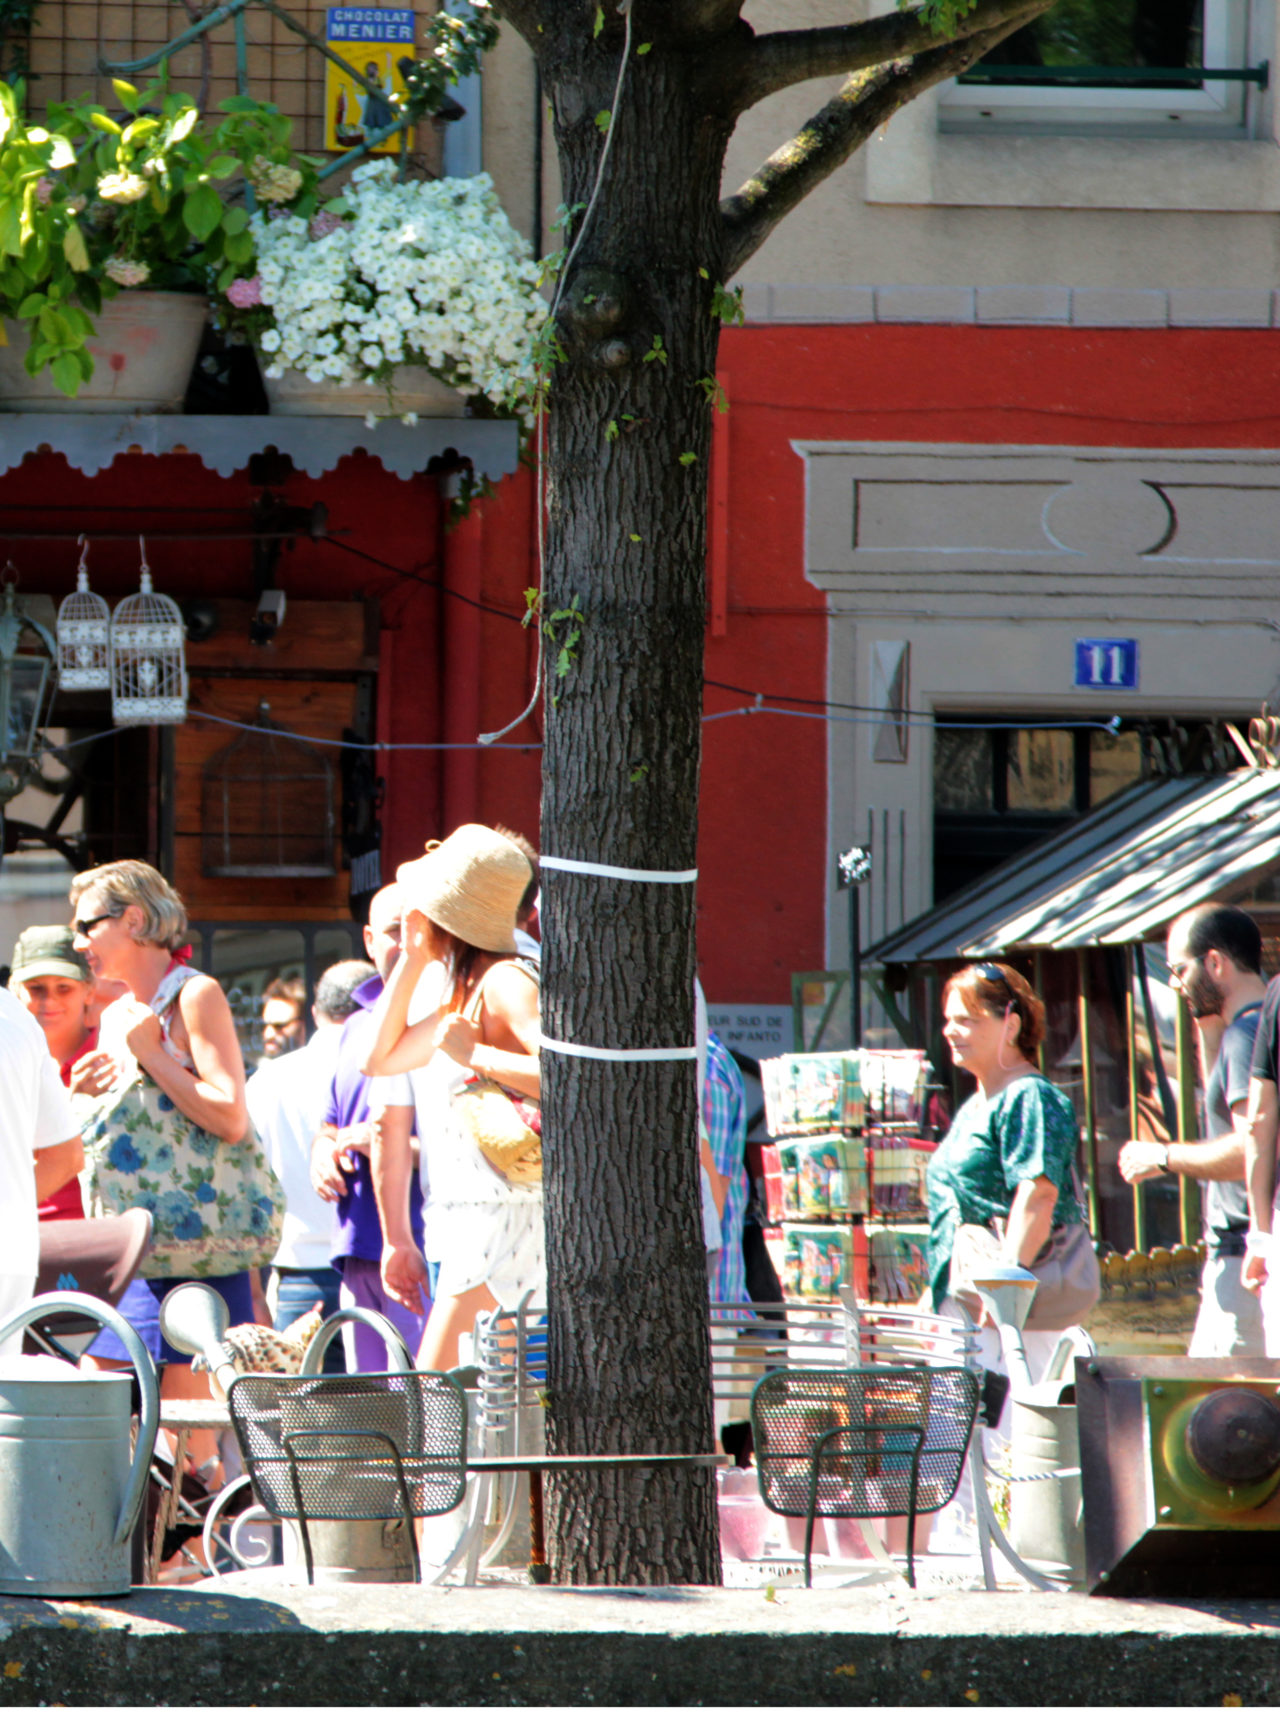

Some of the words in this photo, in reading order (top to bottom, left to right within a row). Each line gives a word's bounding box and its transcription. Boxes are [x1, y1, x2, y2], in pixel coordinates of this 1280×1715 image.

[334, 10, 410, 22] CHOCOLAT
[331, 23, 413, 39] MENIER
[1089, 645, 1123, 683] 11
[708, 1014, 730, 1026] EUR
[736, 1015, 761, 1026] SUD
[766, 1016, 783, 1027] DE
